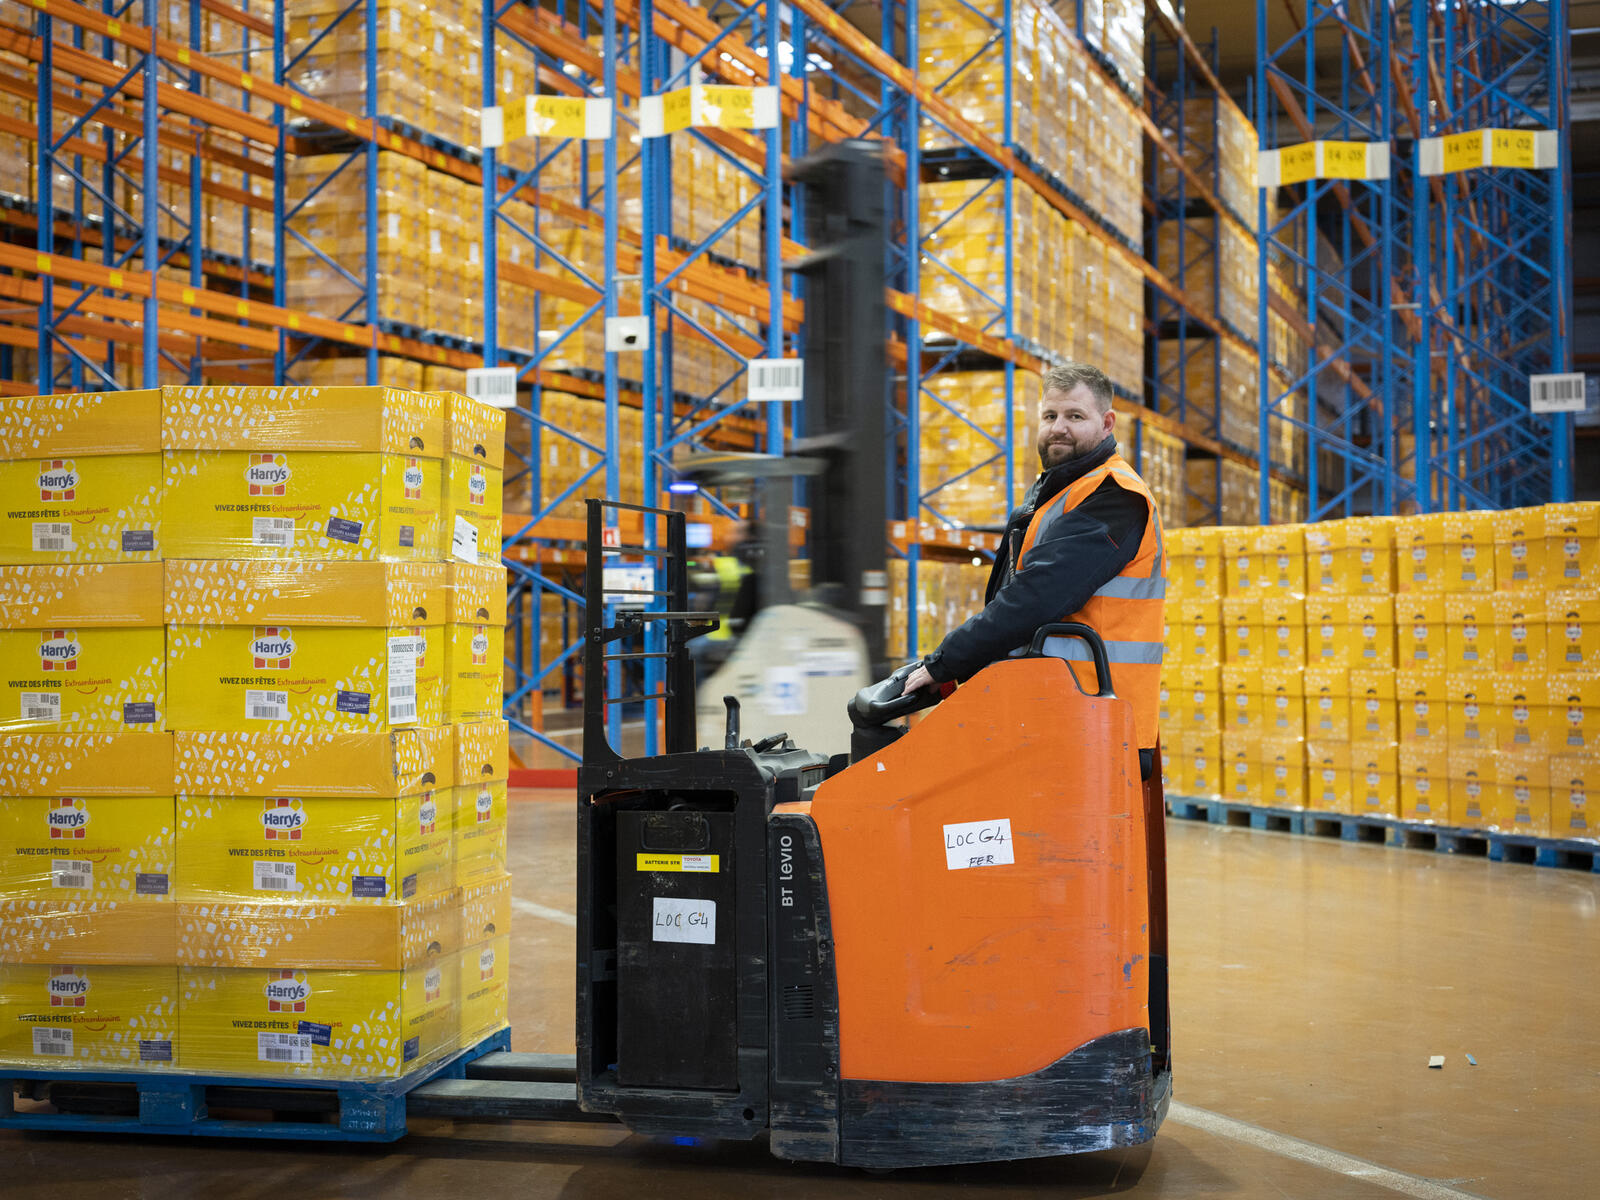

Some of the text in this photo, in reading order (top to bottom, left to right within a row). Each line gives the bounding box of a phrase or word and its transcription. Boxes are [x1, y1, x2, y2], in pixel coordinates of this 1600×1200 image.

[1448, 142, 1460, 154] 14
[1496, 136, 1531, 150] 14 02
[214, 504, 235, 512] VIVEZ
[236, 504, 250, 512] DES
[250, 502, 270, 512] FÊTES
[40, 509, 60, 518] FÊTES
[8, 680, 28, 688] VIVEZ
[28, 680, 41, 688] DES
[42, 678, 62, 688] FÊTES
[255, 676, 276, 685] FÊTES
[947, 826, 1004, 848] LOC G4
[50, 846, 70, 855] FÊTES
[228, 848, 249, 856] VIVEZ
[264, 848, 286, 856] FÊTES
[969, 854, 994, 868] FER
[782, 887, 794, 906] BT
[656, 912, 708, 928] LOC G4
[52, 1014, 72, 1022] FÊTES
[232, 1020, 252, 1028] VIVEZ
[254, 1020, 267, 1028] DES
[268, 1018, 289, 1028] FÊTES
